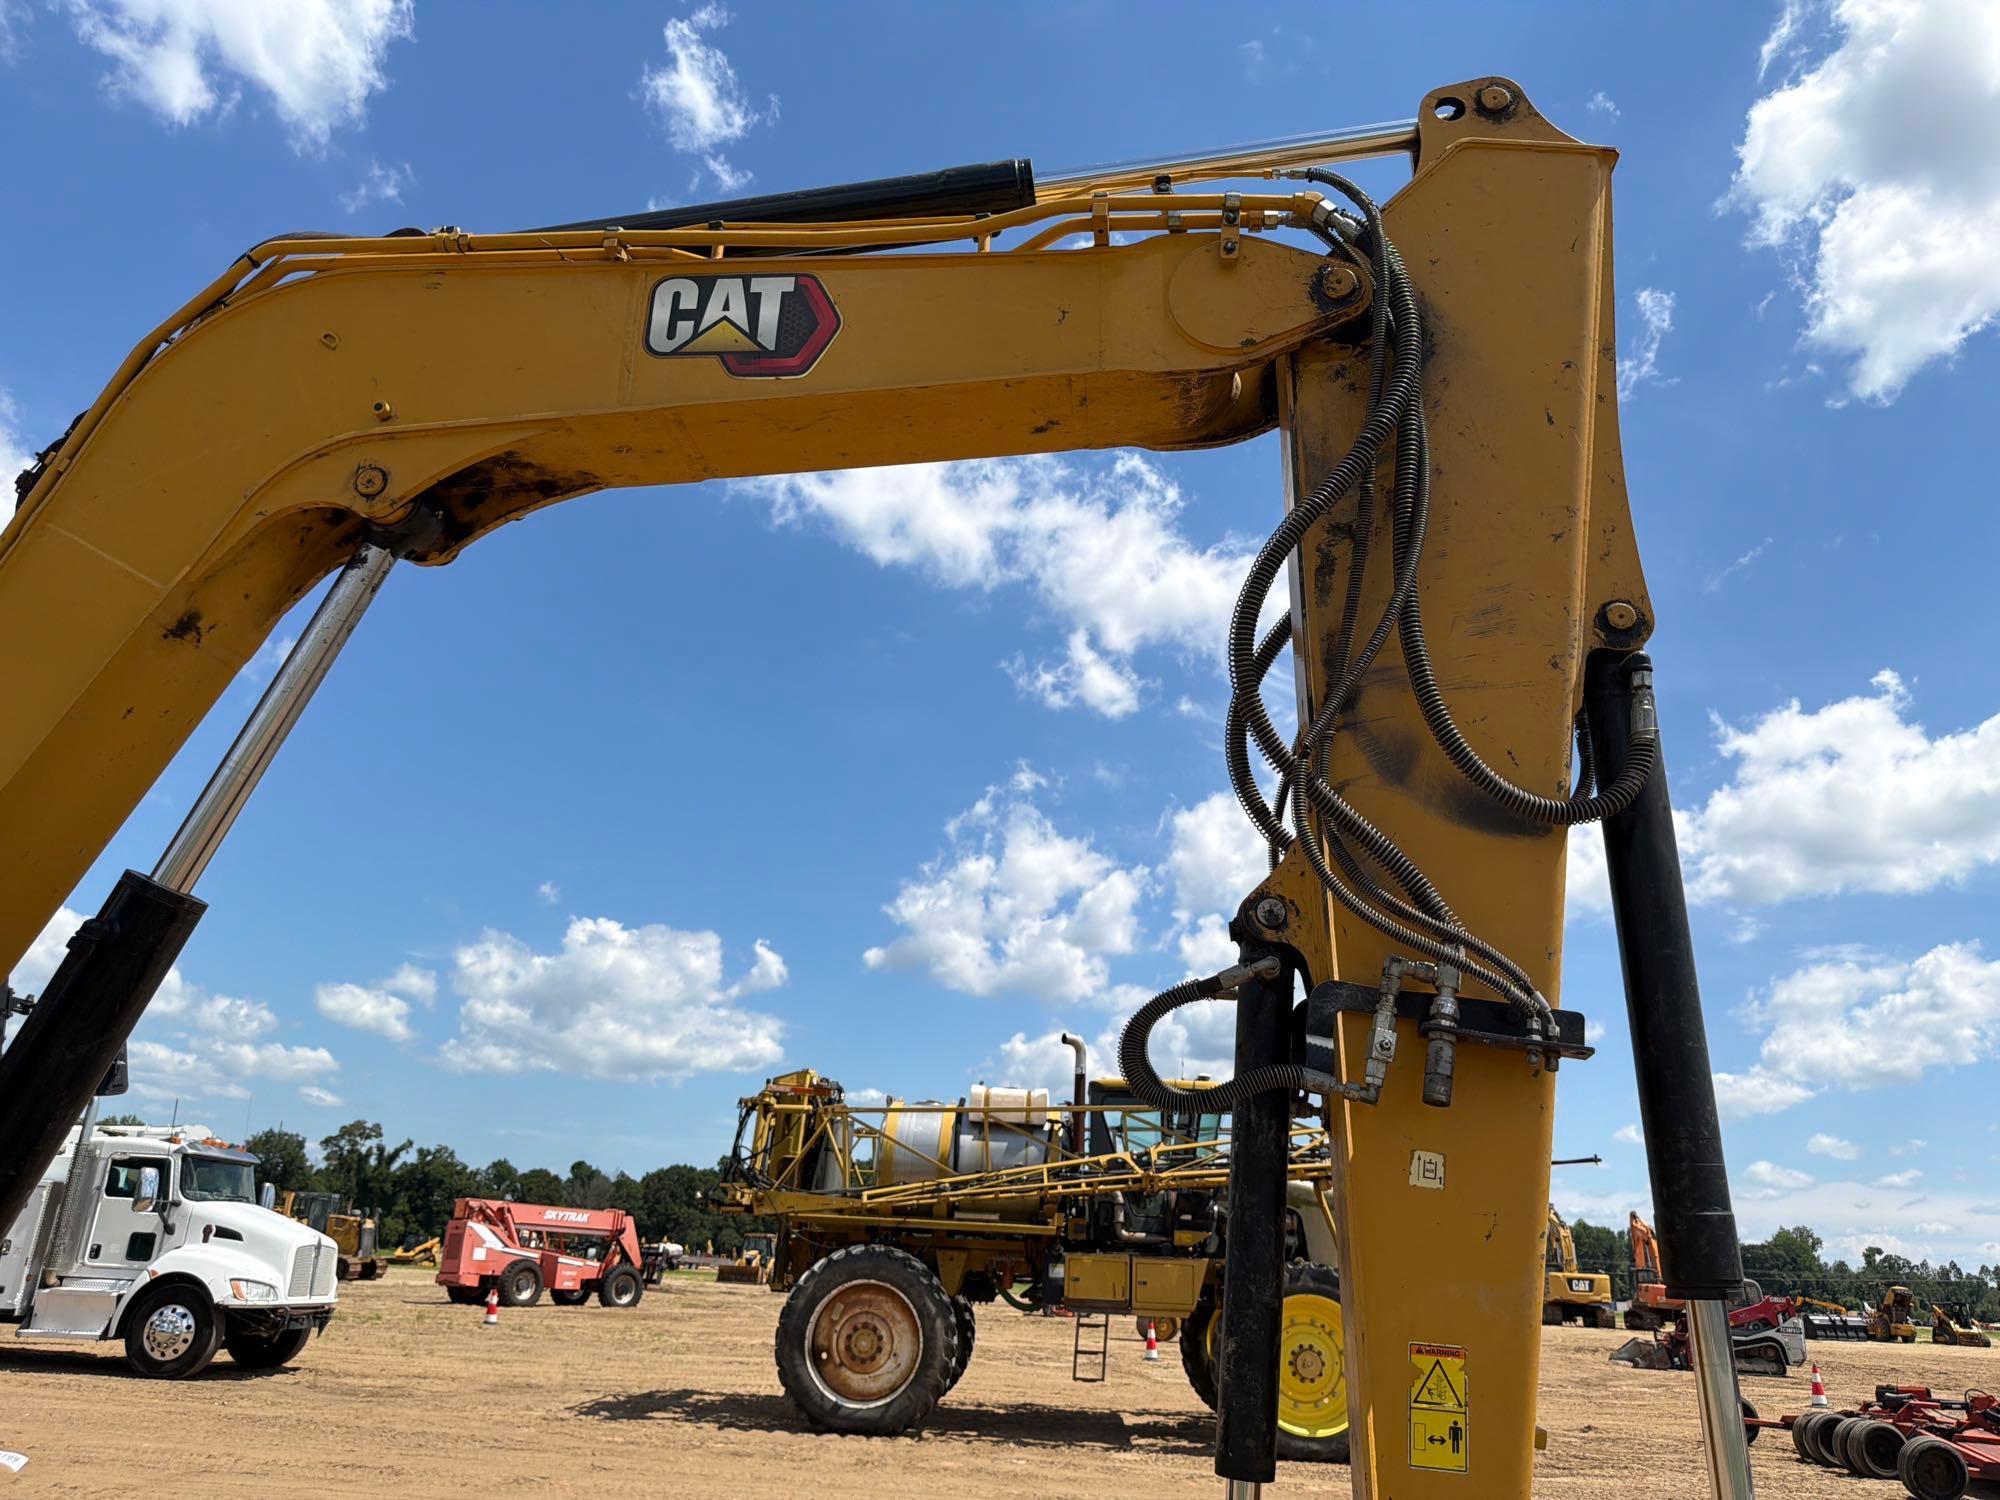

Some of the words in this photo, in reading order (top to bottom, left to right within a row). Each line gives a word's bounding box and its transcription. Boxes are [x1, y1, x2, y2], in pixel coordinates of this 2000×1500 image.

[649, 277, 795, 353] CAT
[544, 1209, 590, 1223] SKYTRAK
[1572, 1279, 1590, 1291] CAT
[1424, 1348, 1461, 1358] WARNING
